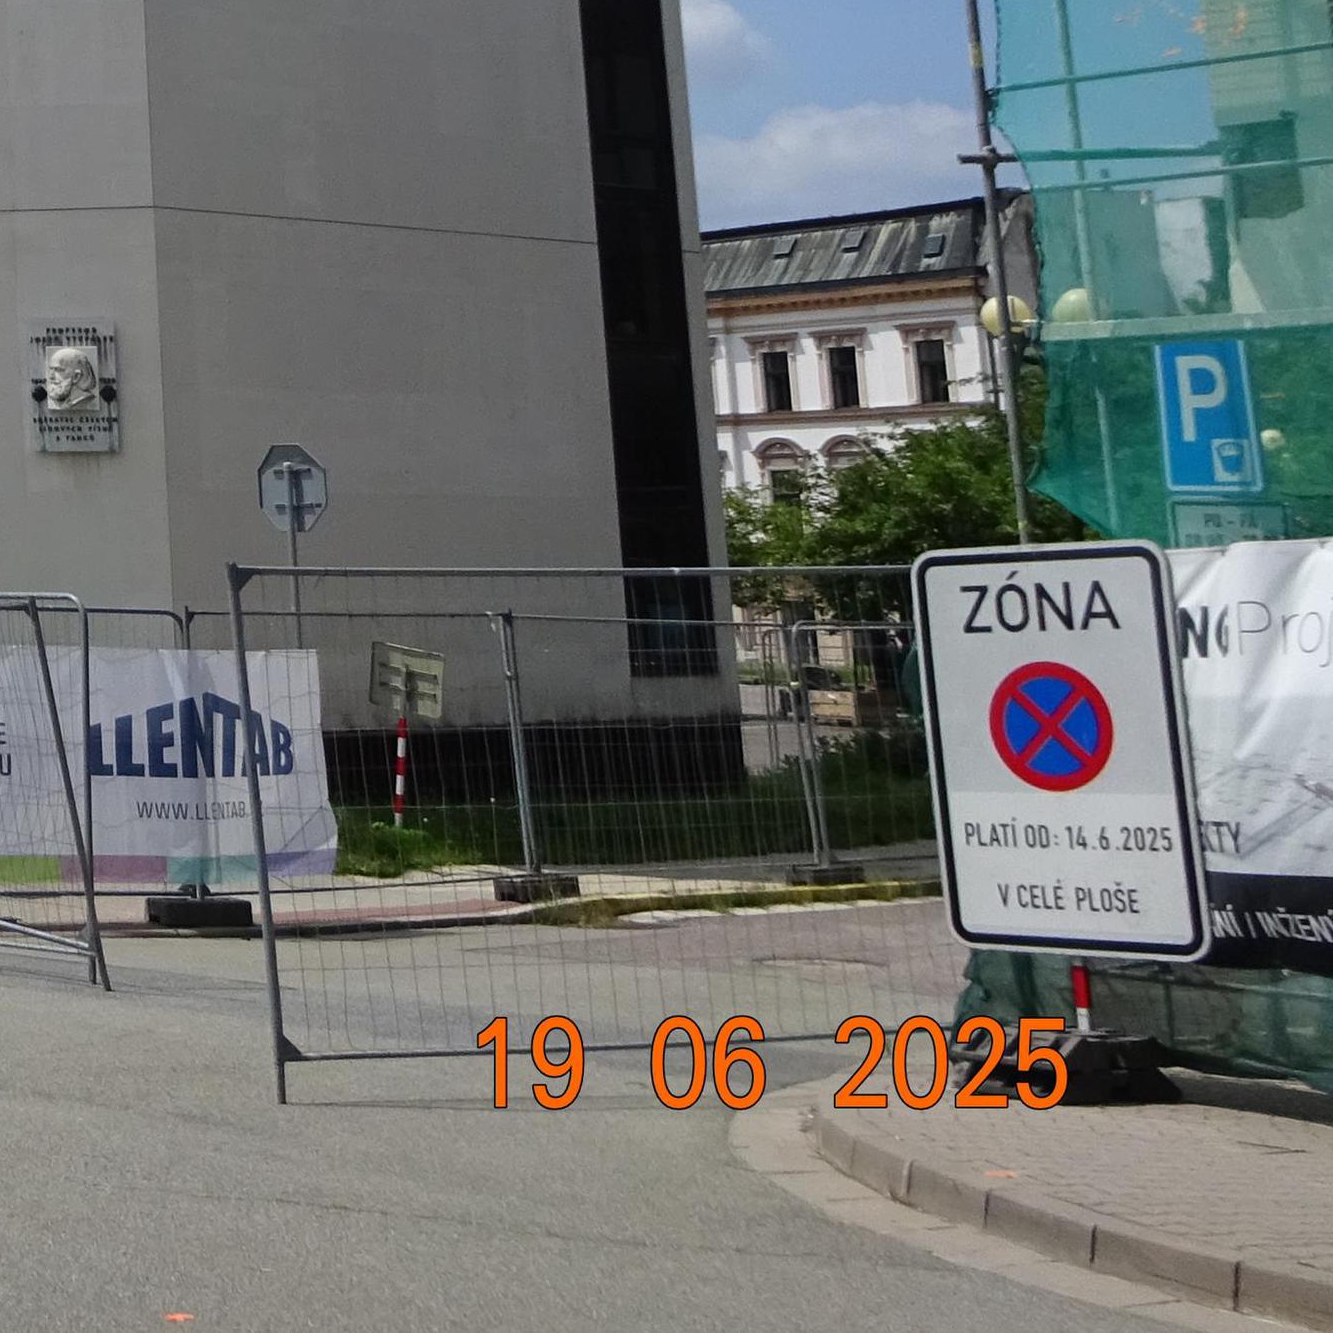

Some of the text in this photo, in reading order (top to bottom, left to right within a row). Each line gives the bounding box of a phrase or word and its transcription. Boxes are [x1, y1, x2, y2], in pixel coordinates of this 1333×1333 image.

[1174, 354, 1228, 443] P
[959, 570, 1122, 634] ZÓNA
[90, 692, 294, 778] LLENTAB
[964, 817, 1174, 853] PLATÍ OD: 14.6.2025
[997, 878, 1141, 914] V CELÉ PLOŠE
